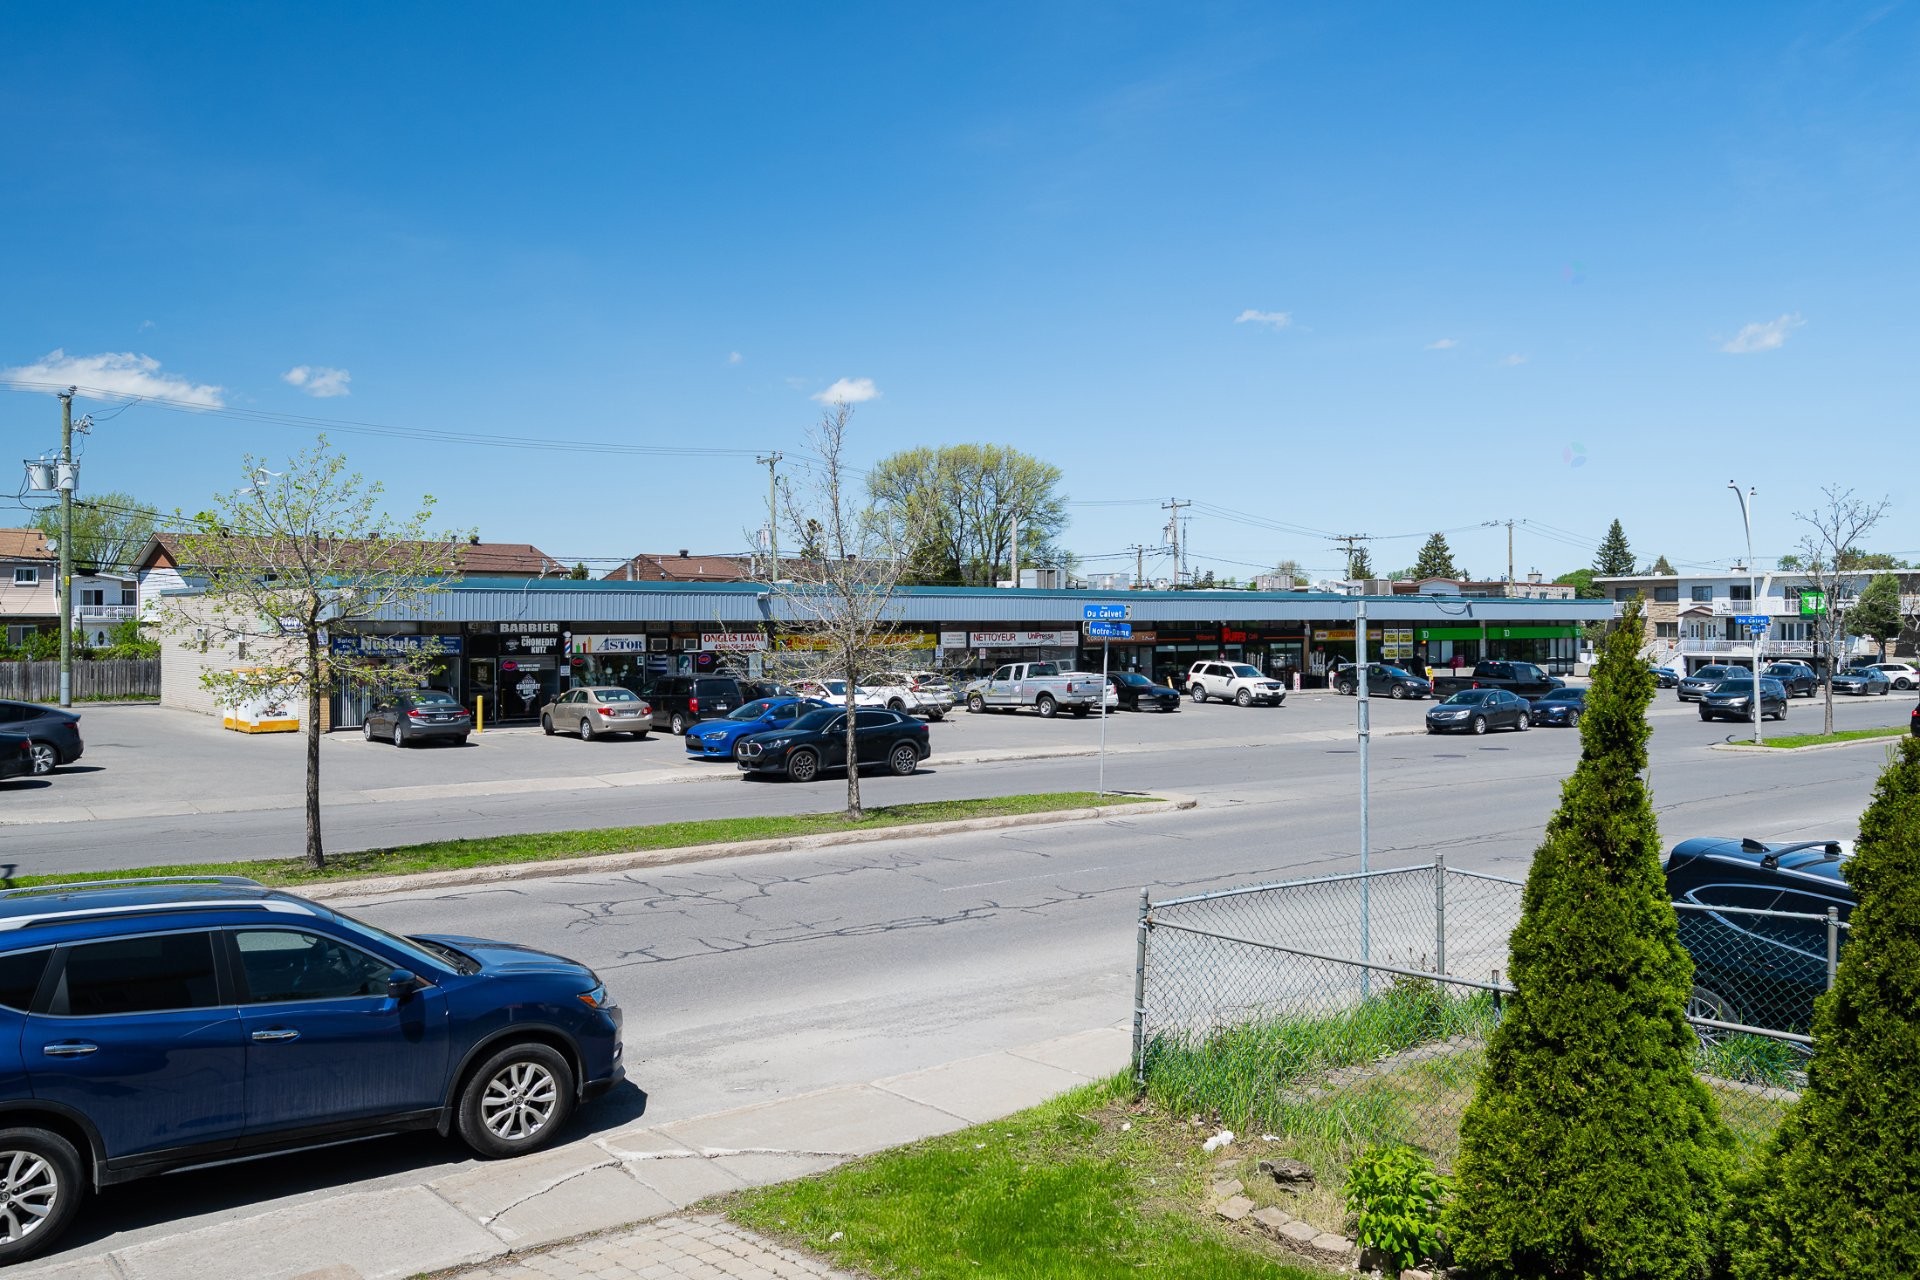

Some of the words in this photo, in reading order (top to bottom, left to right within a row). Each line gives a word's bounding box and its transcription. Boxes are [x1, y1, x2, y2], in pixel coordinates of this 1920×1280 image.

[1804, 596, 1826, 609] TD
[500, 623, 559, 633] BARBIER
[1091, 628, 1130, 637] Notre-Dame
[521, 637, 557, 647] CHOMEDEY
[703, 634, 738, 643] ONGLES
[740, 633, 765, 642] LAVAL
[973, 632, 1016, 642] NETTOYEUR
[596, 636, 643, 651] ASTOR
[531, 646, 547, 654] KUTZ
